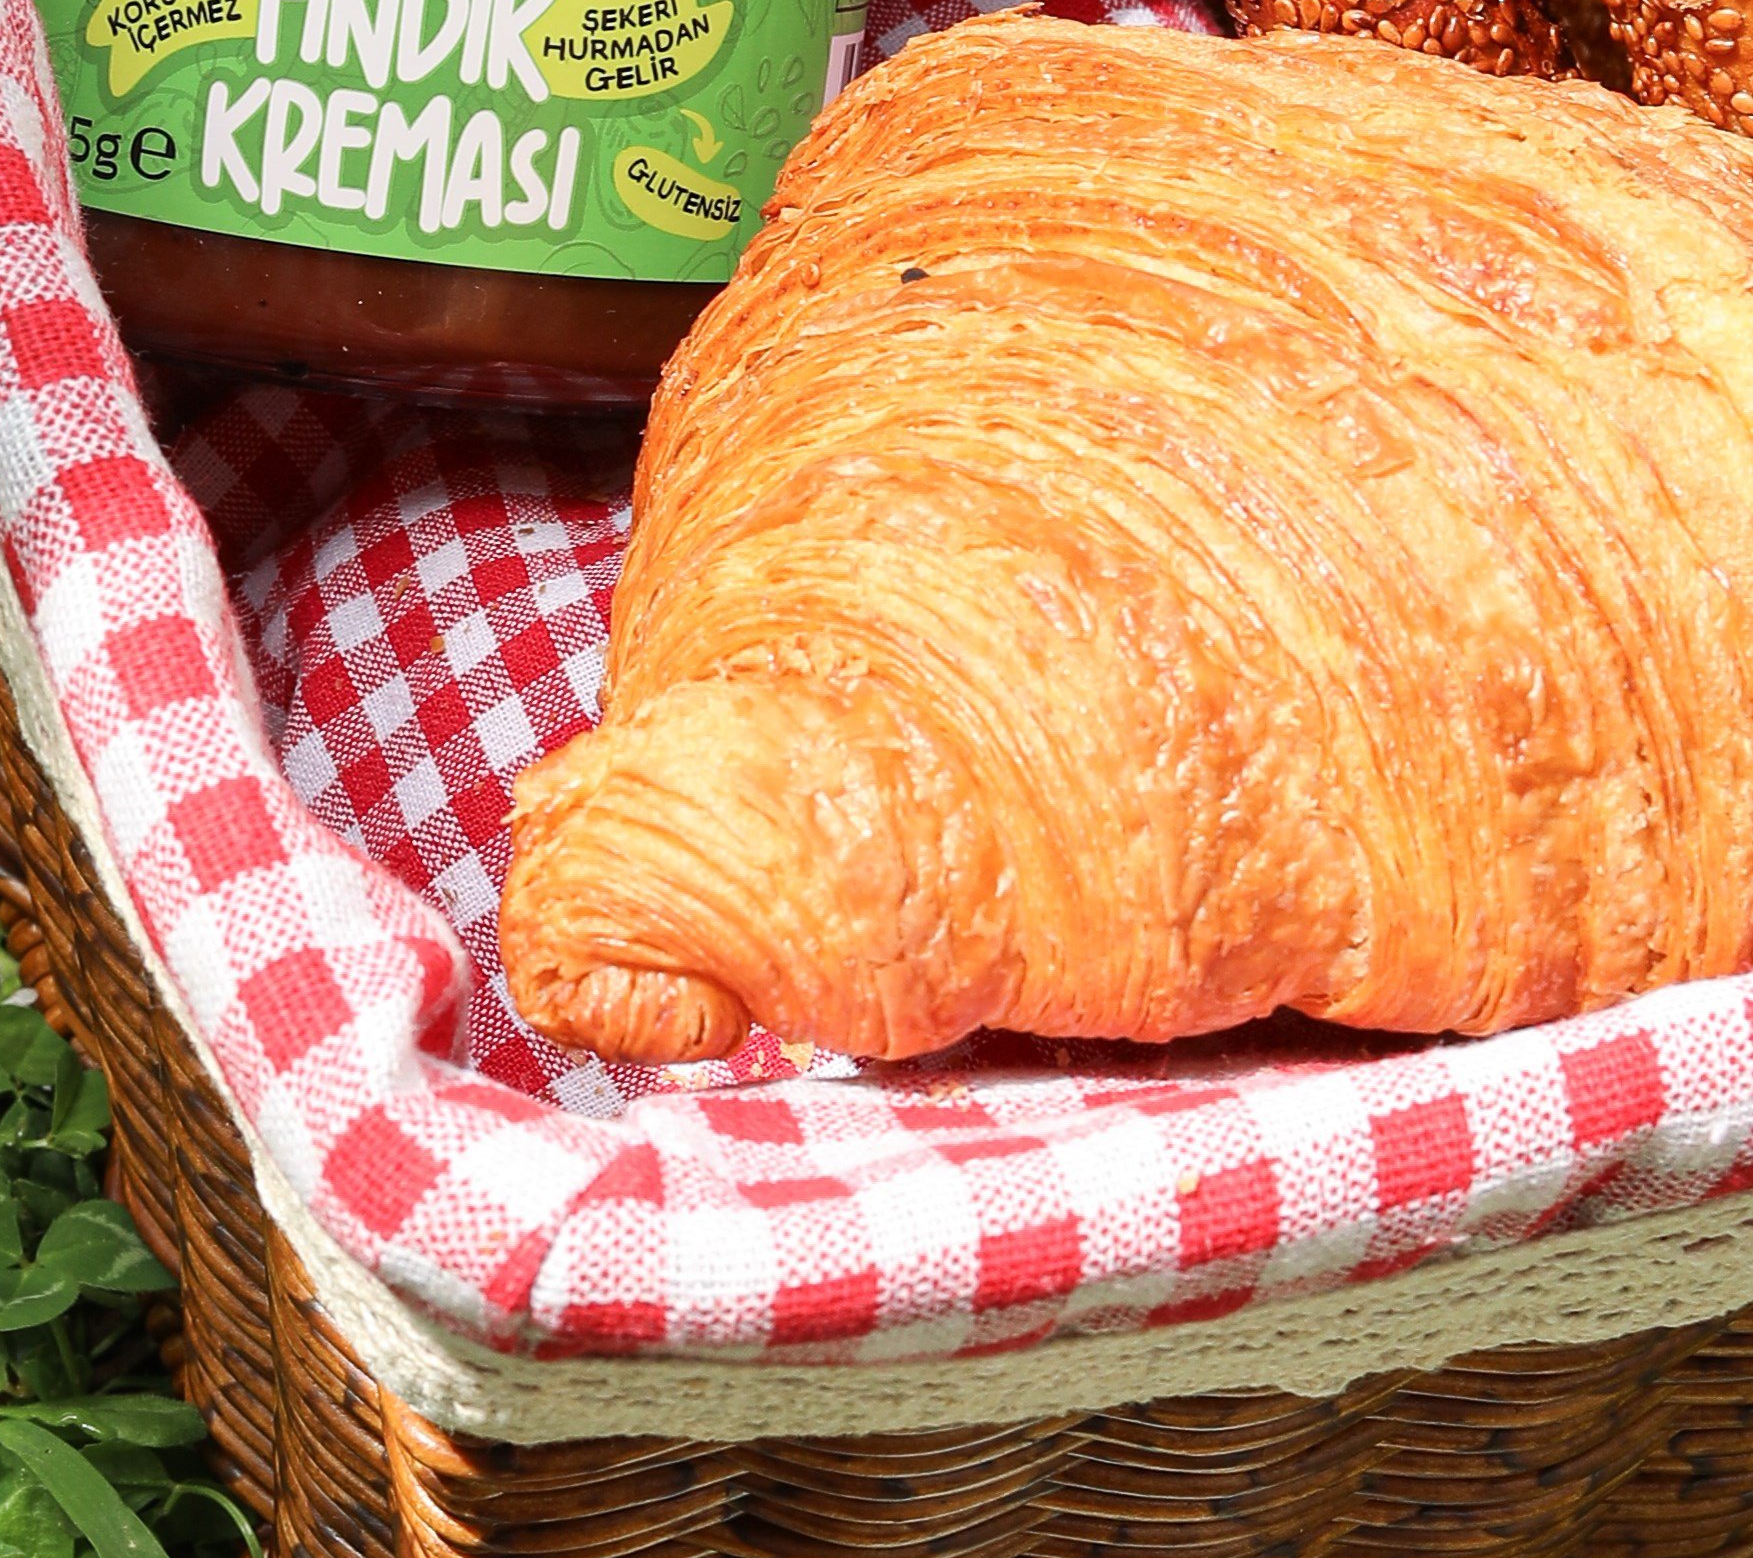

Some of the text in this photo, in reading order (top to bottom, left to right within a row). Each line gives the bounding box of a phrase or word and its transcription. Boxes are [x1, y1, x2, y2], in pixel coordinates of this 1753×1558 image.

[542, 13, 711, 61] HURMADAN
[584, 55, 680, 92] GELİR
[201, 76, 581, 234] KREMASI
[626, 157, 743, 224] GLUTENSİZ
